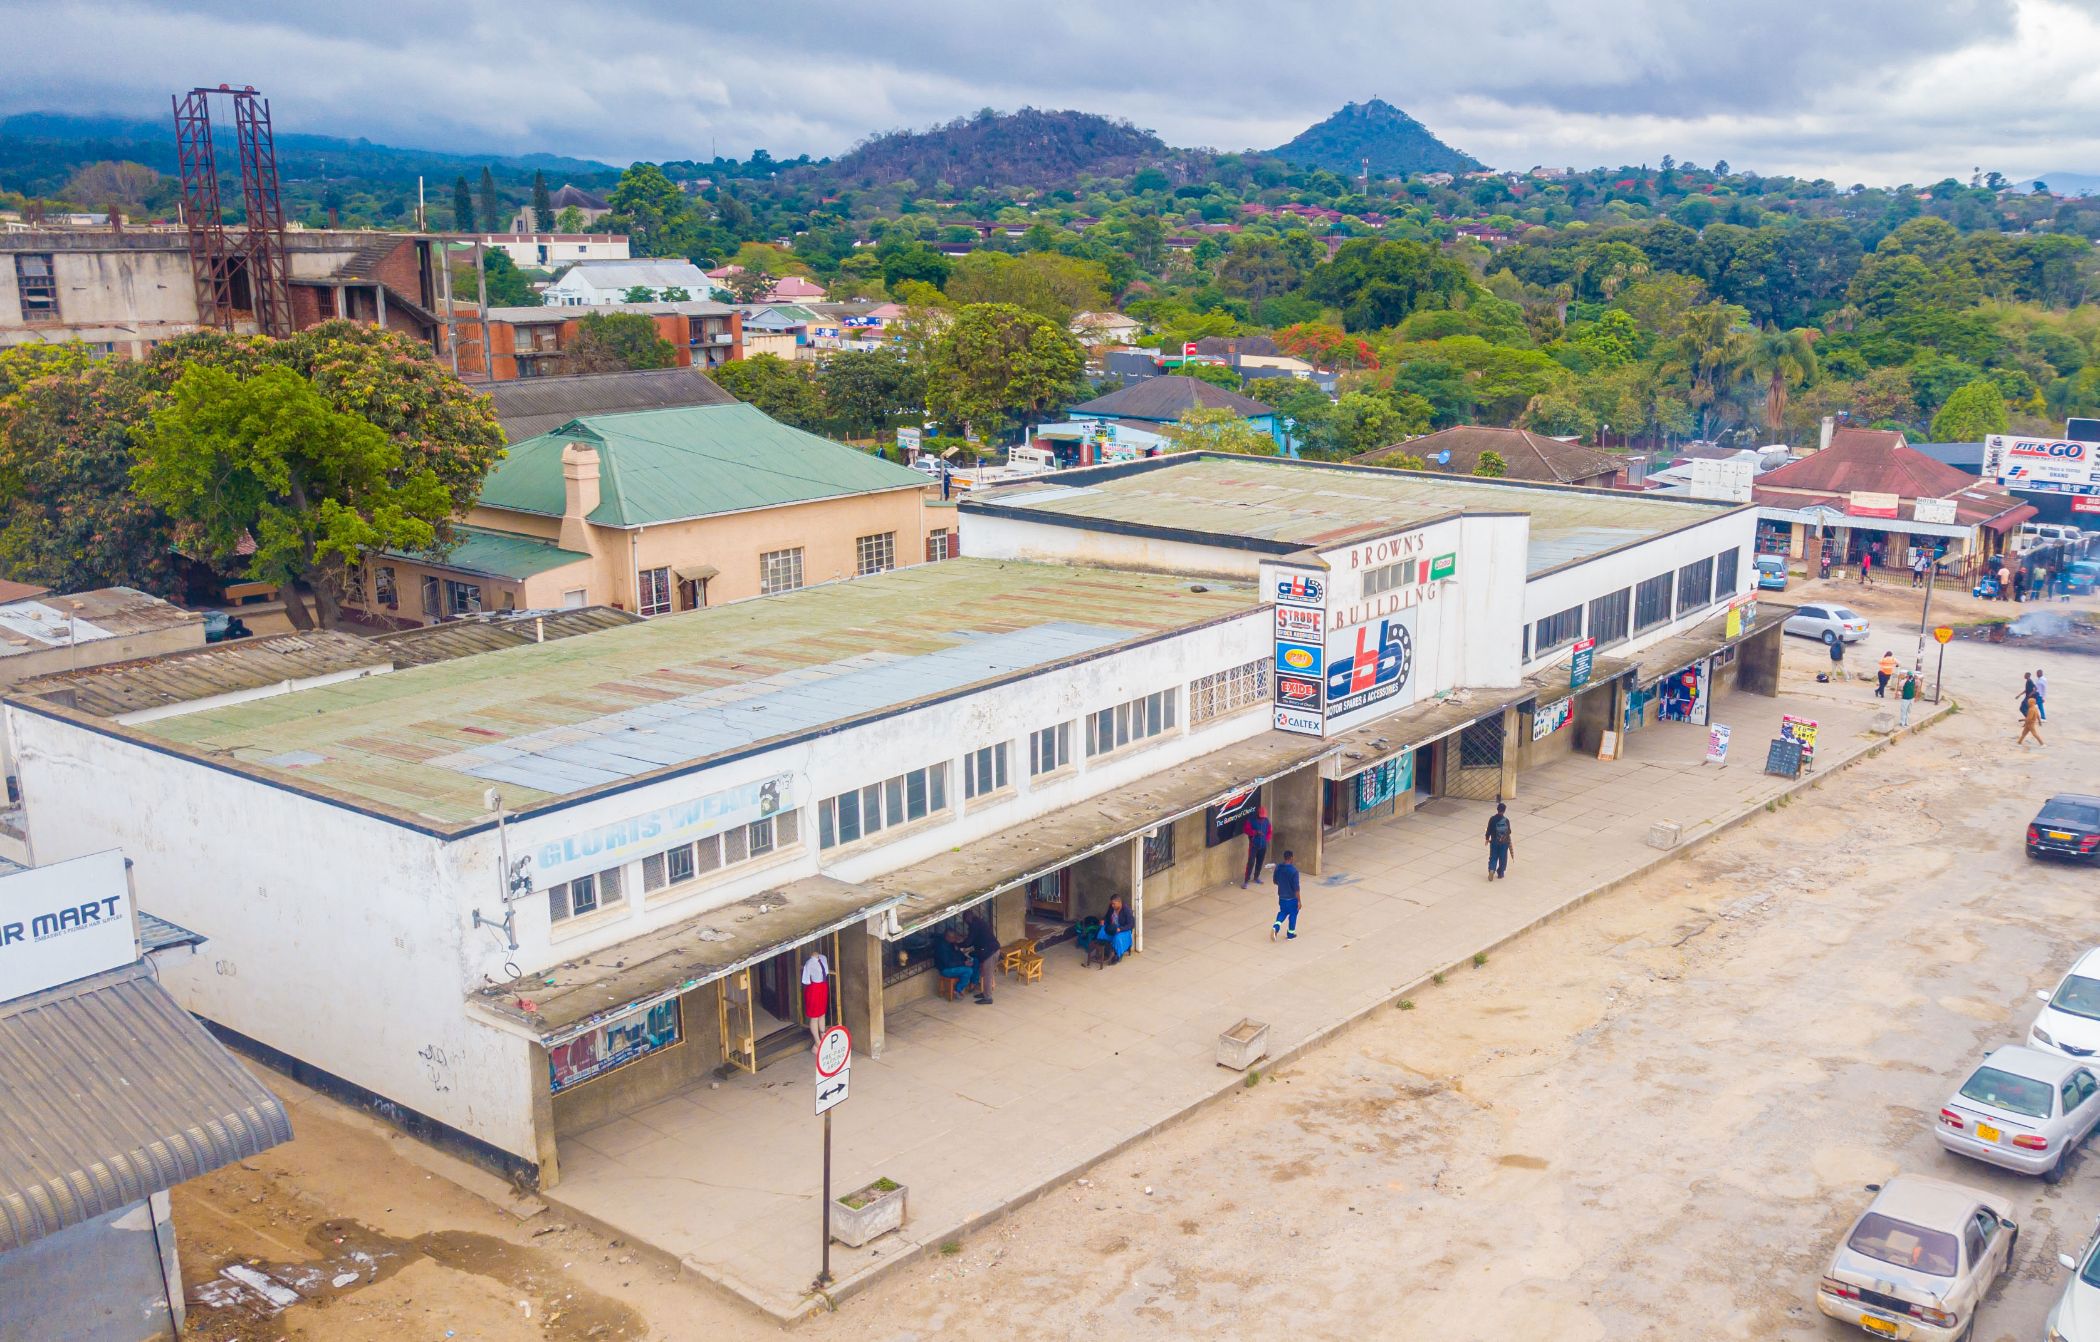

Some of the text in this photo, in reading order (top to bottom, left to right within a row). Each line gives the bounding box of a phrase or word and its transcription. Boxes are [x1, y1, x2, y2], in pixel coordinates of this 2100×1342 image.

[2015, 442, 2083, 458] FIT & GO
[1351, 534, 1424, 569] BROWN'S
[1336, 583, 1436, 629] BUILDING
[1278, 609, 1321, 631] STROBE
[1281, 681, 1313, 695] EXIDE
[1288, 717, 1320, 730] CALTEX
[32, 895, 120, 937] MART
[830, 1033, 839, 1050] P
